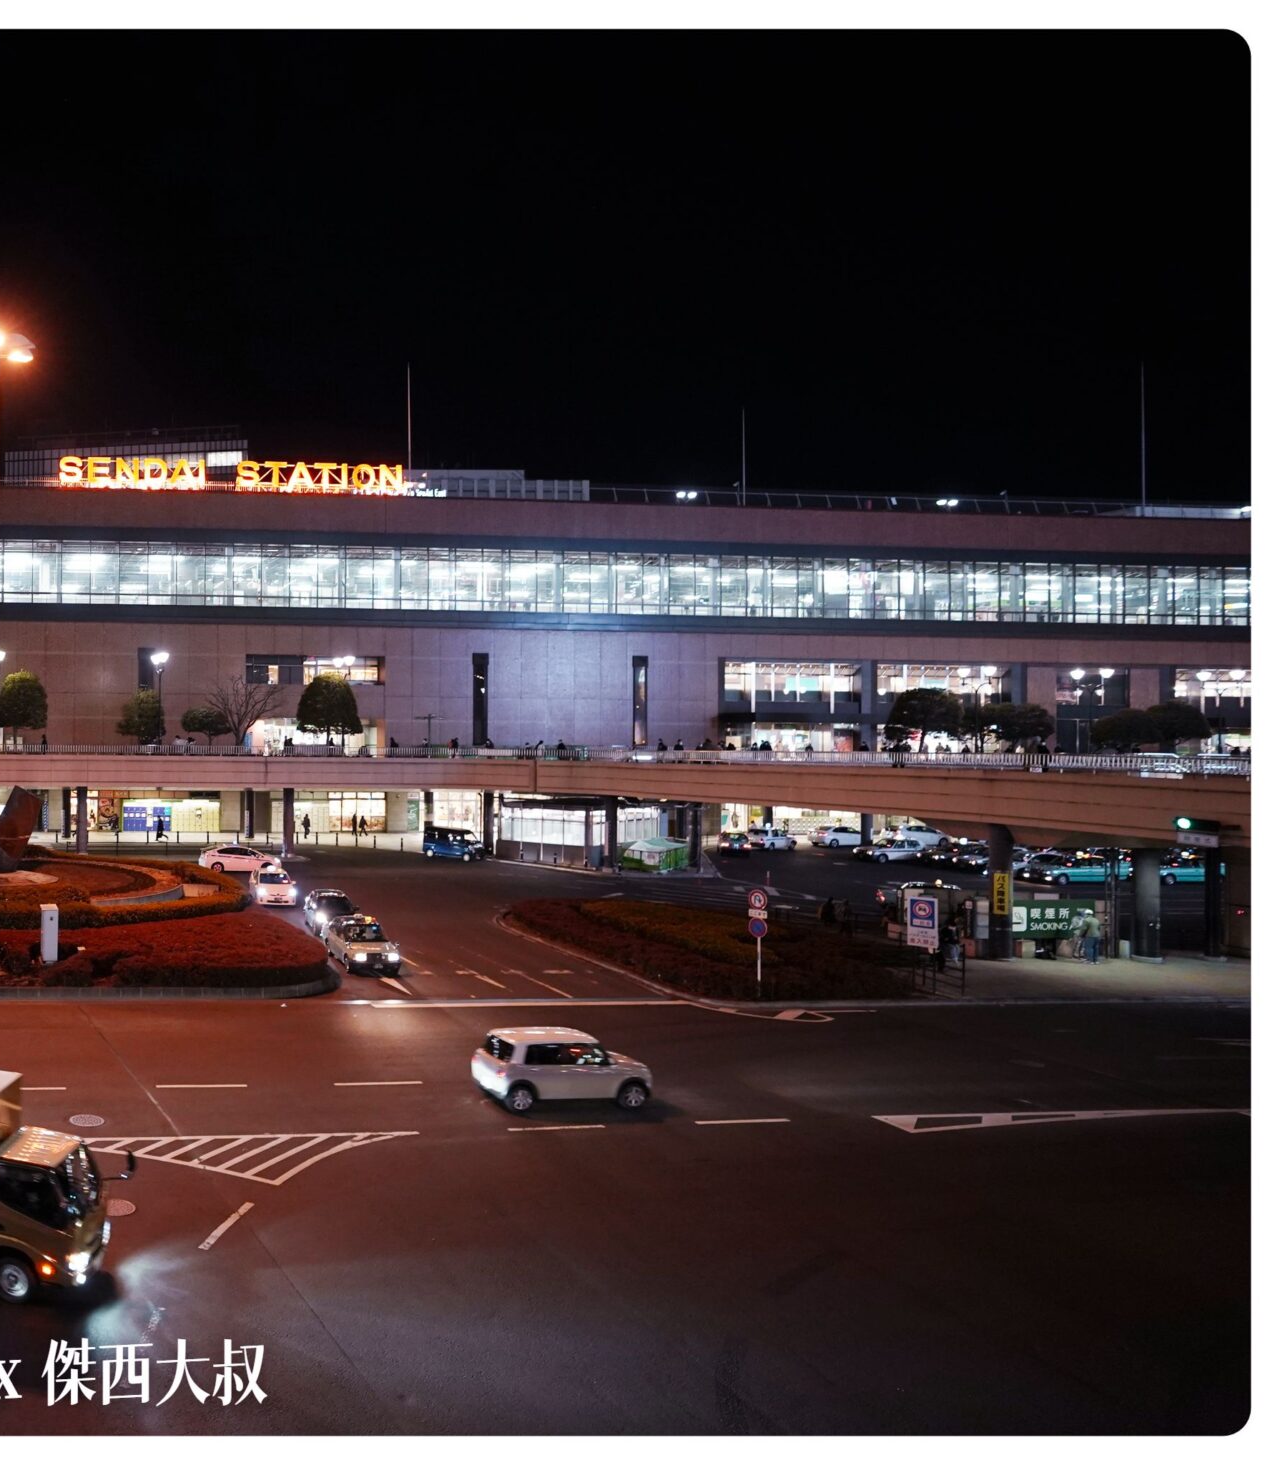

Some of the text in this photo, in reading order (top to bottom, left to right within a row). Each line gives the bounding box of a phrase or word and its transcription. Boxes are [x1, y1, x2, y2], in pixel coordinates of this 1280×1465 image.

[59, 456, 403, 491] SENDAI STATION
[1030, 907, 1070, 919] 喫煙所
[1030, 922, 1068, 931] SMOKING
